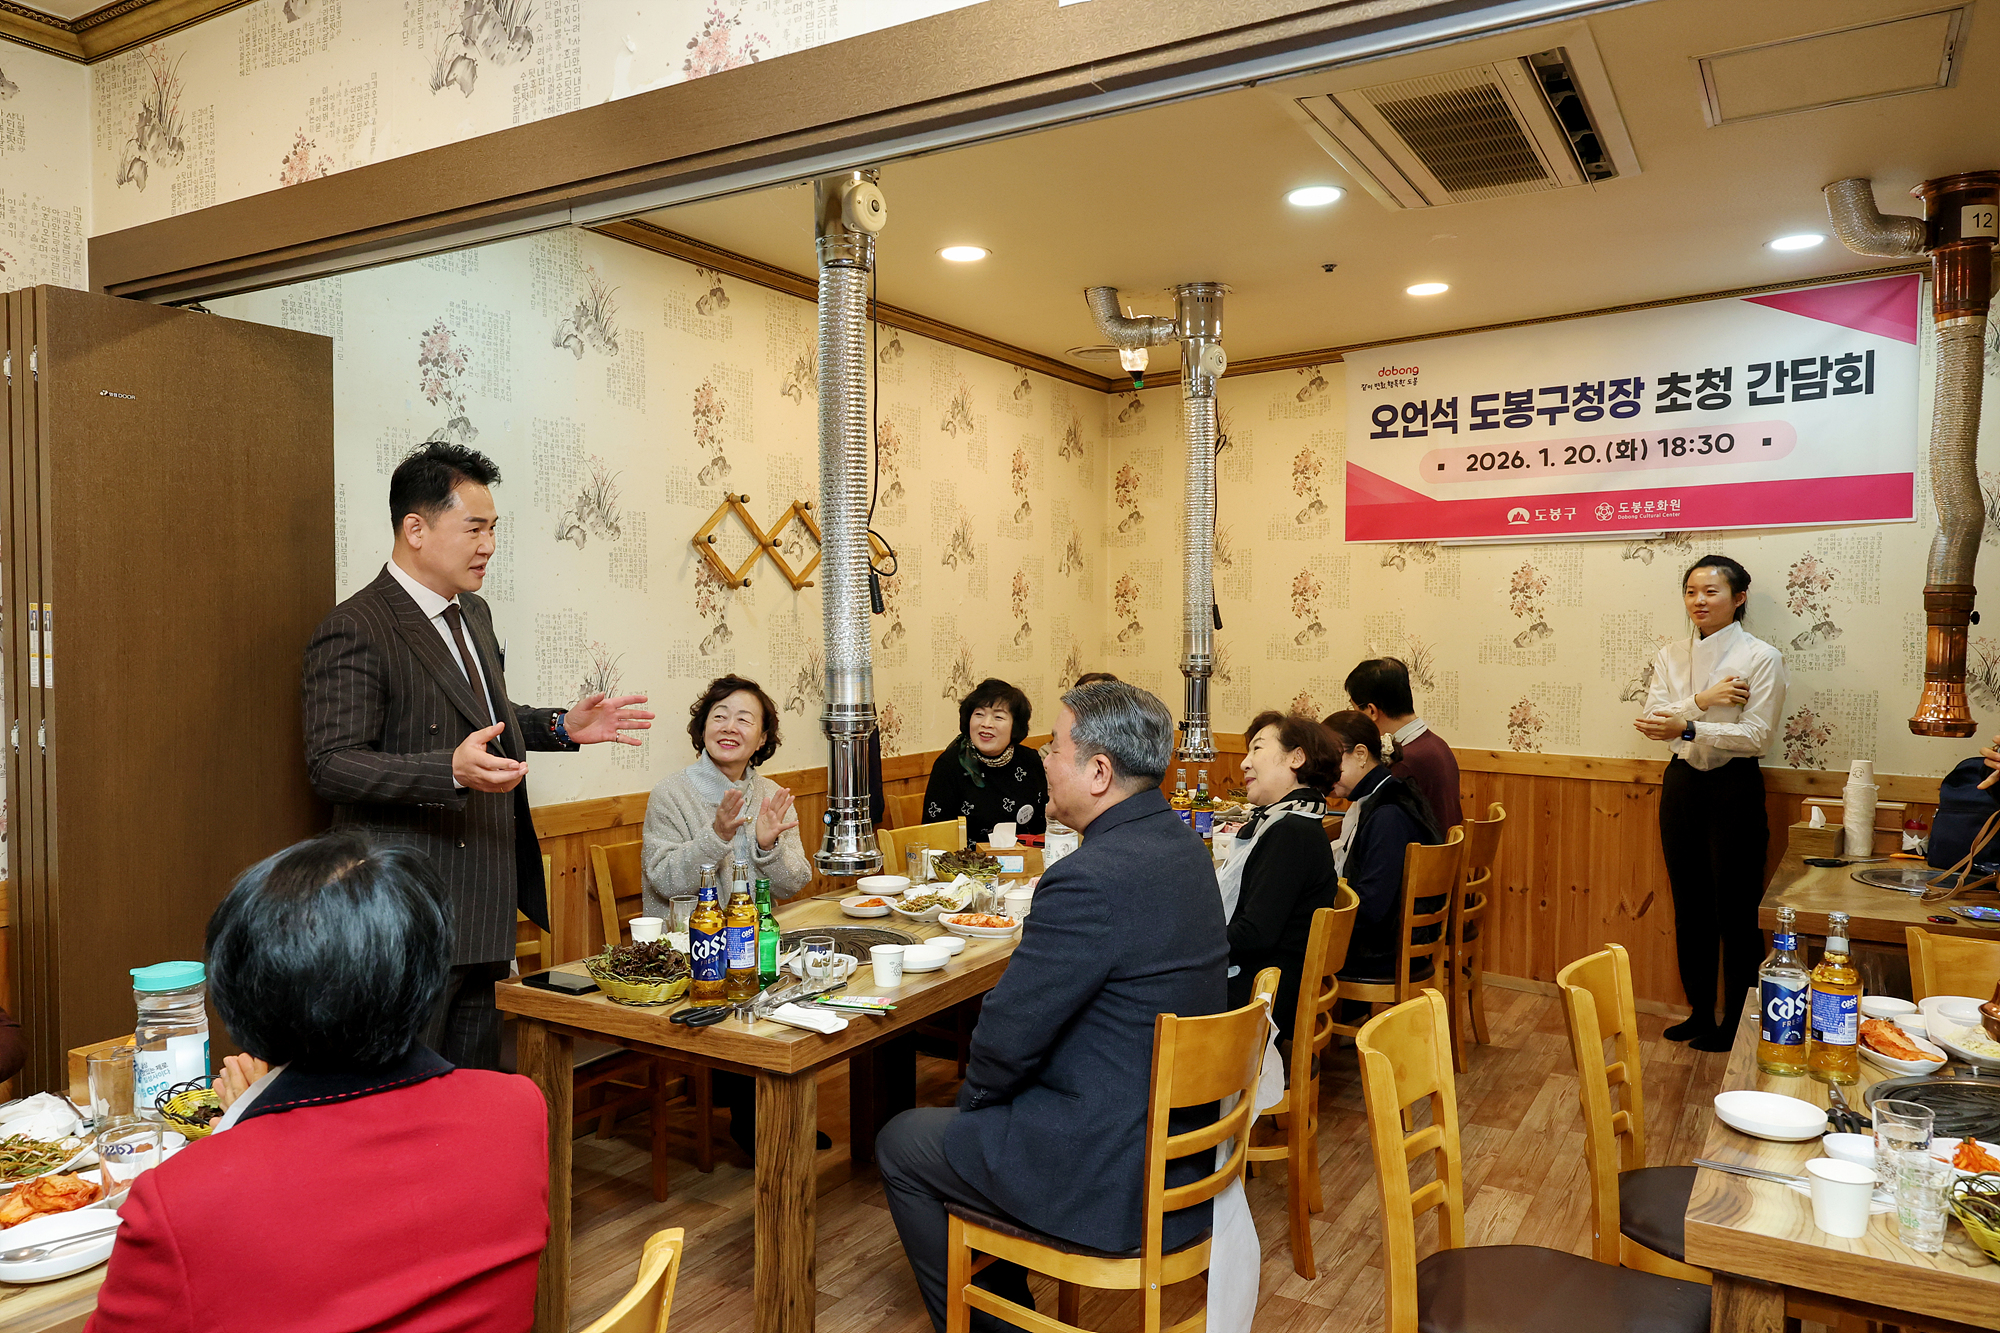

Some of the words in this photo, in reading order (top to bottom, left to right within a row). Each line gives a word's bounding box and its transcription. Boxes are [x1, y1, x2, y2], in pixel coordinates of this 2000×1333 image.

[1972, 212, 1993, 229] 12
[1378, 366, 1419, 377] dobong
[1407, 377, 1419, 387] 도봉
[1369, 396, 1459, 440] 오언석
[1469, 376, 1645, 431] 도봉구청장
[1655, 366, 1733, 414] 초청
[1747, 349, 1876, 407] 간담회
[1465, 449, 1532, 473] 2026.
[1538, 447, 1556, 468] 1.
[1656, 433, 1736, 458] 18:30
[1617, 498, 1681, 514] 도봉문화원
[1534, 507, 1577, 523] 도봉구
[700, 954, 720, 966] FRESH
[1767, 992, 1808, 1022] Cas
[1782, 1016, 1803, 1028] FRES
